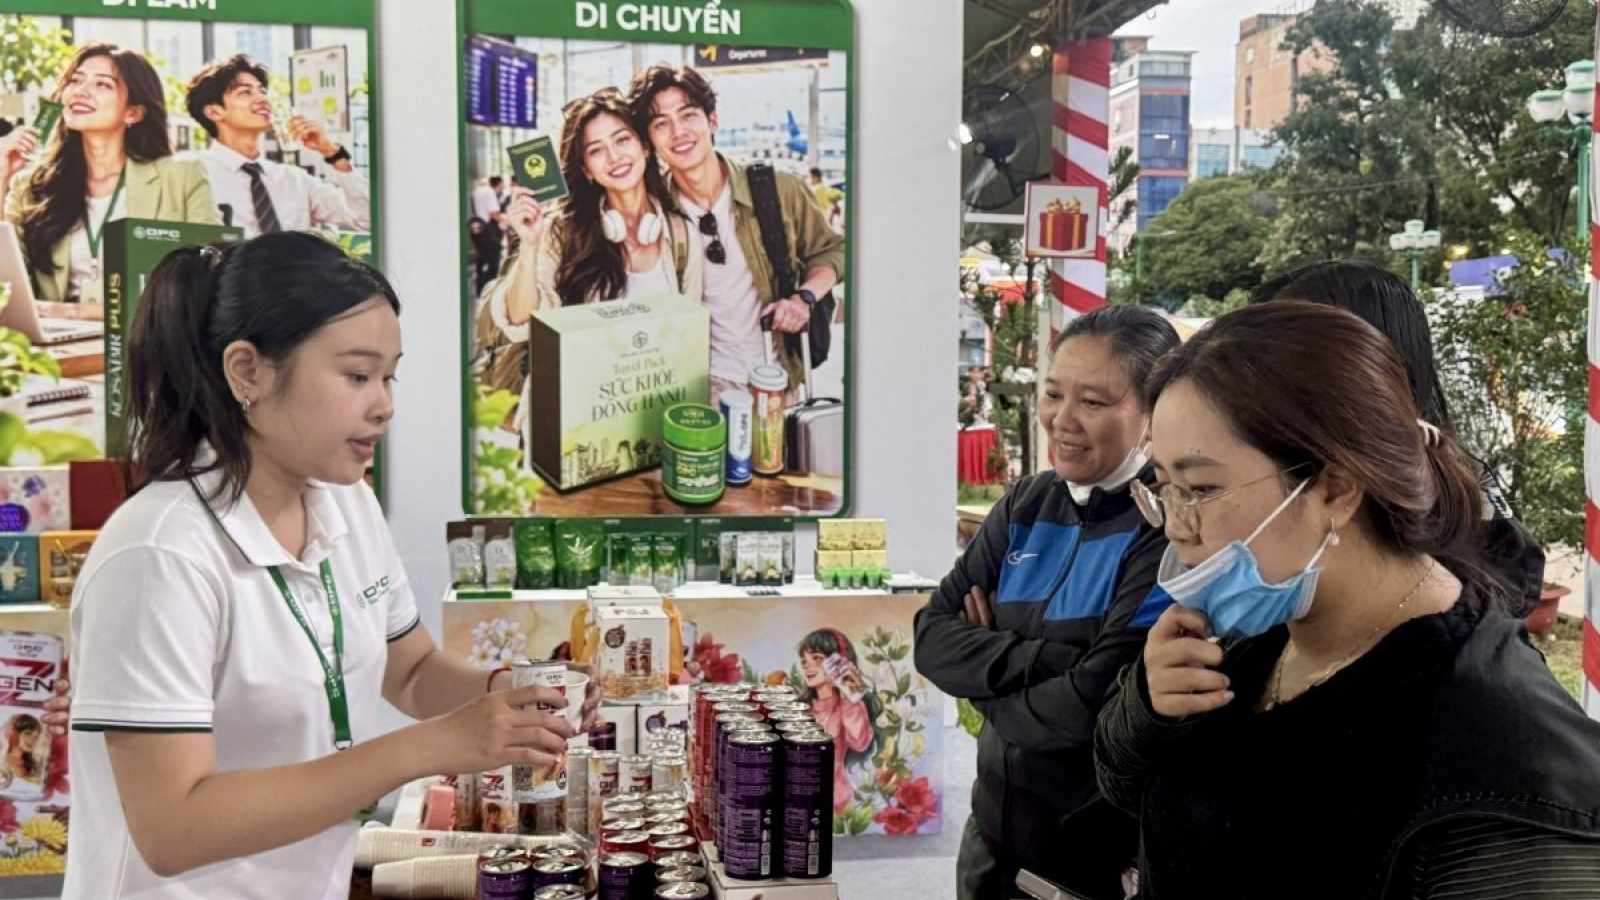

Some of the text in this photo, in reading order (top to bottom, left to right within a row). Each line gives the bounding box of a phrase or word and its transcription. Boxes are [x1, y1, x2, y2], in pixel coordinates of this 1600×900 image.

[576, 0, 741, 35] DI CHUYỂN
[109, 273, 121, 329] PLUS
[0, 675, 56, 692] GEN
